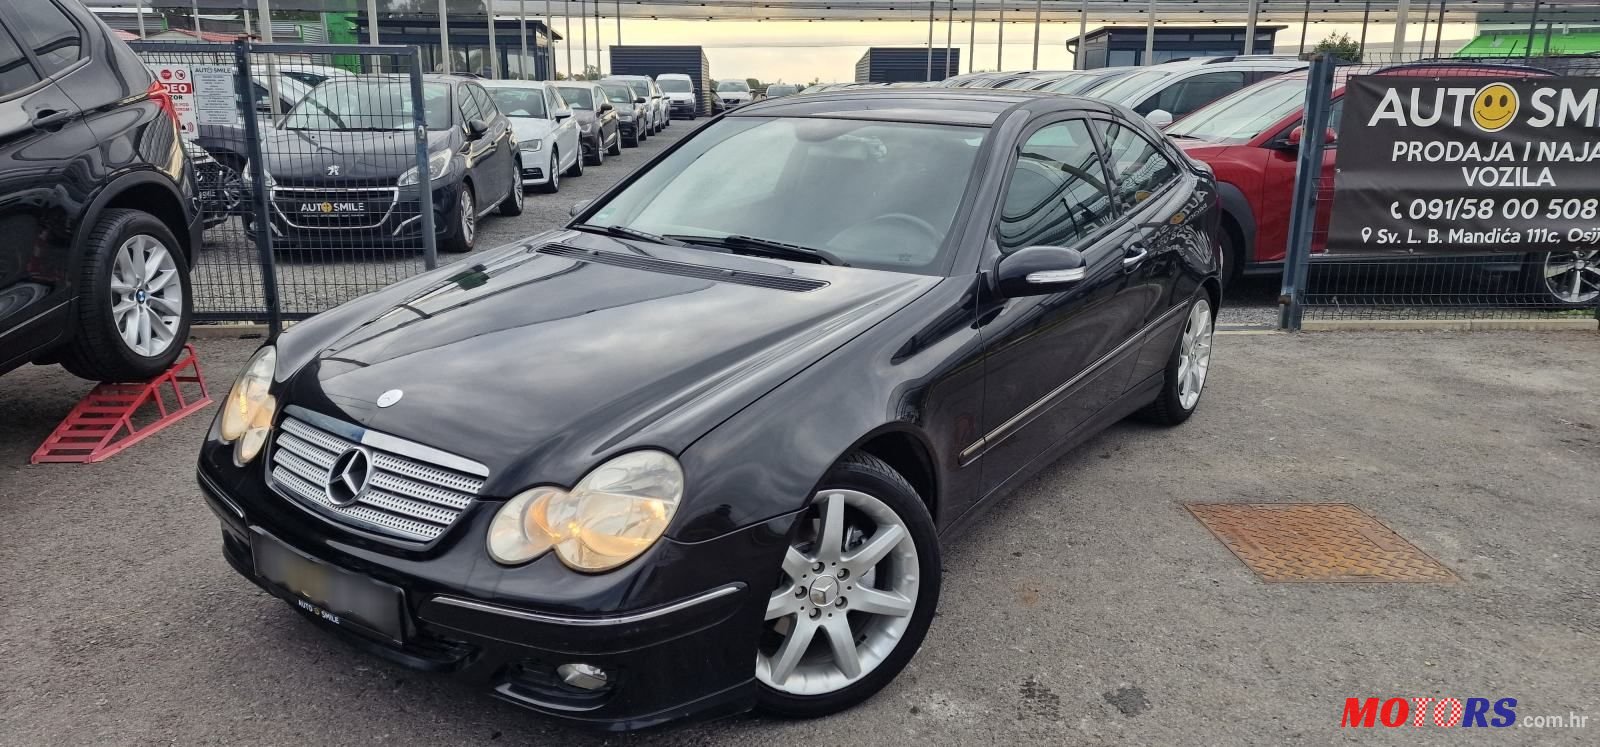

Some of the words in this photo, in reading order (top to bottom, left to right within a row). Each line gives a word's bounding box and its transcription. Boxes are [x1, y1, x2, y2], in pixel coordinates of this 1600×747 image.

[1391, 141, 1515, 162] PRODAJA
[1522, 141, 1532, 162] I
[1462, 166, 1556, 187] VOZILA
[333, 202, 365, 212] SMILE
[1408, 198, 1494, 221] 091/58
[1502, 198, 1539, 220] 00
[1546, 198, 1598, 220] 508
[1377, 229, 1401, 244] Sv.
[1407, 228, 1421, 243] L.
[1428, 228, 1443, 243] B.
[1448, 227, 1521, 243] Mandića
[1526, 228, 1561, 245] 111c,
[298, 600, 313, 612] AUTO
[321, 610, 340, 624] SMILE
